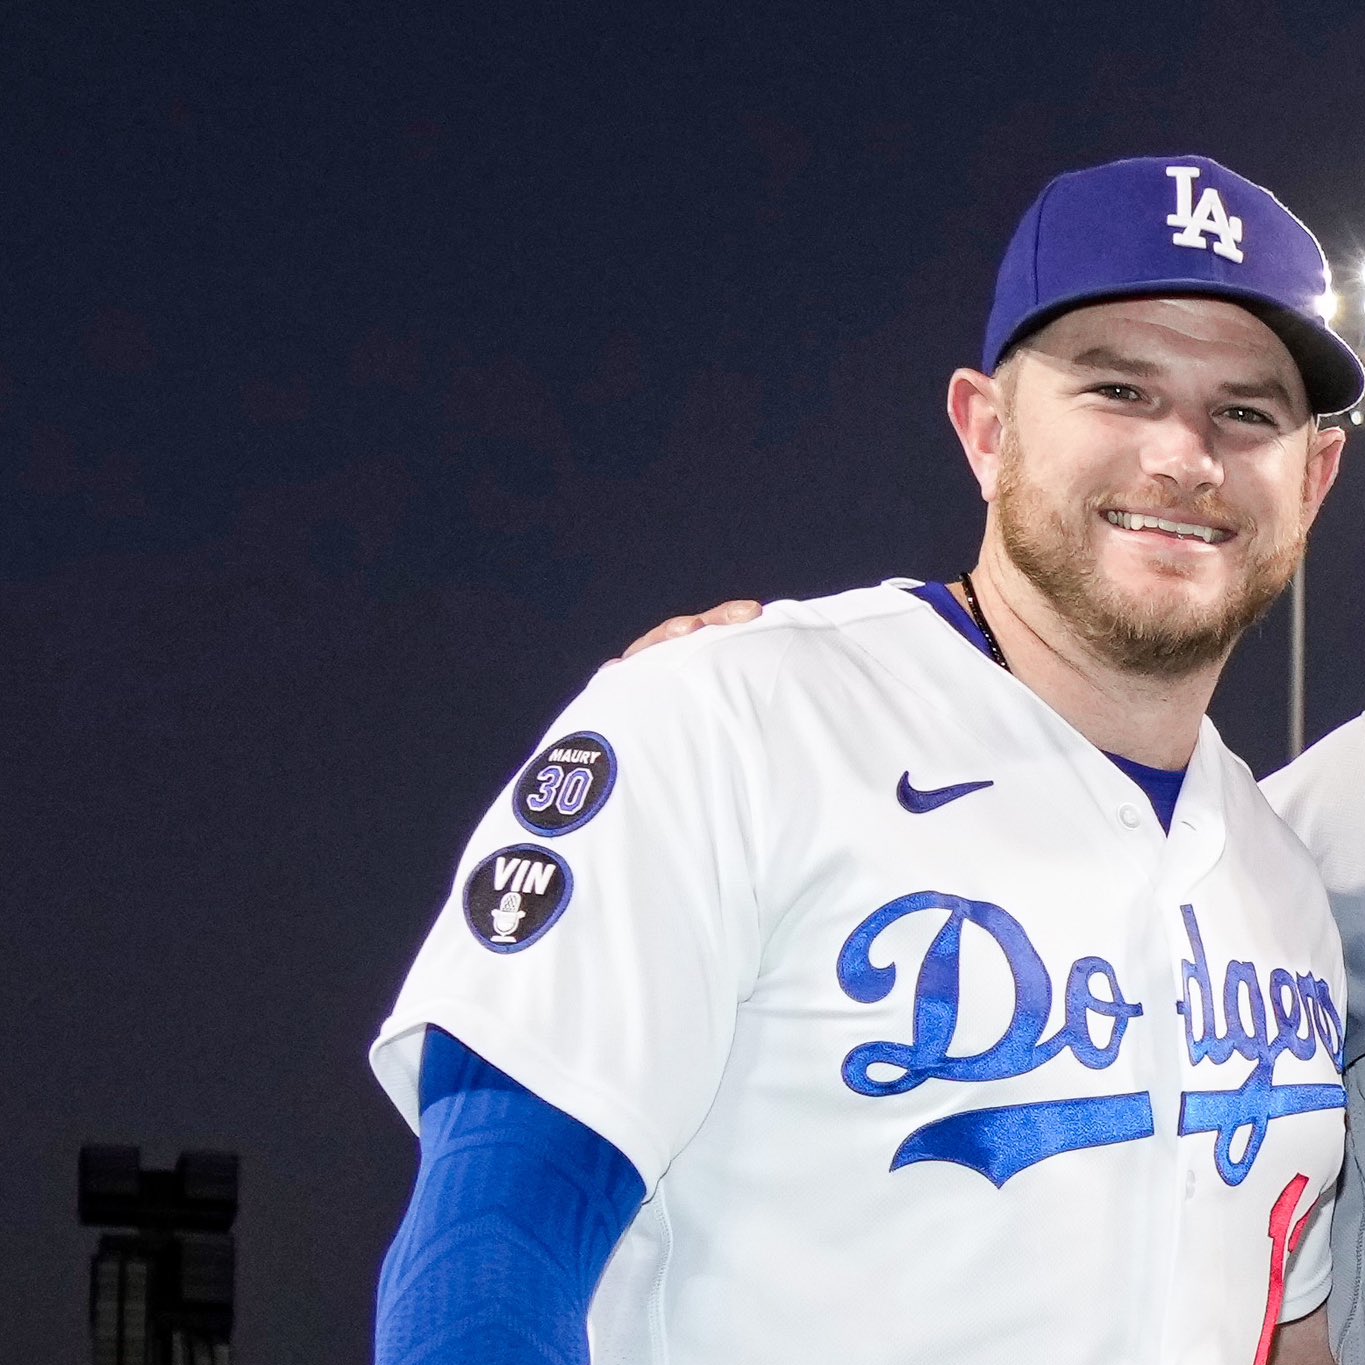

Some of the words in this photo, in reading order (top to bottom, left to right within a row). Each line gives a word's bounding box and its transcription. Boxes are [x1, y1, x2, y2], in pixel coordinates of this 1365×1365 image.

[1166, 166, 1244, 264] LA
[548, 748, 602, 765] MAURY
[526, 765, 594, 815] 30
[494, 856, 557, 896] VIN
[836, 890, 1348, 1188] Dodgers
